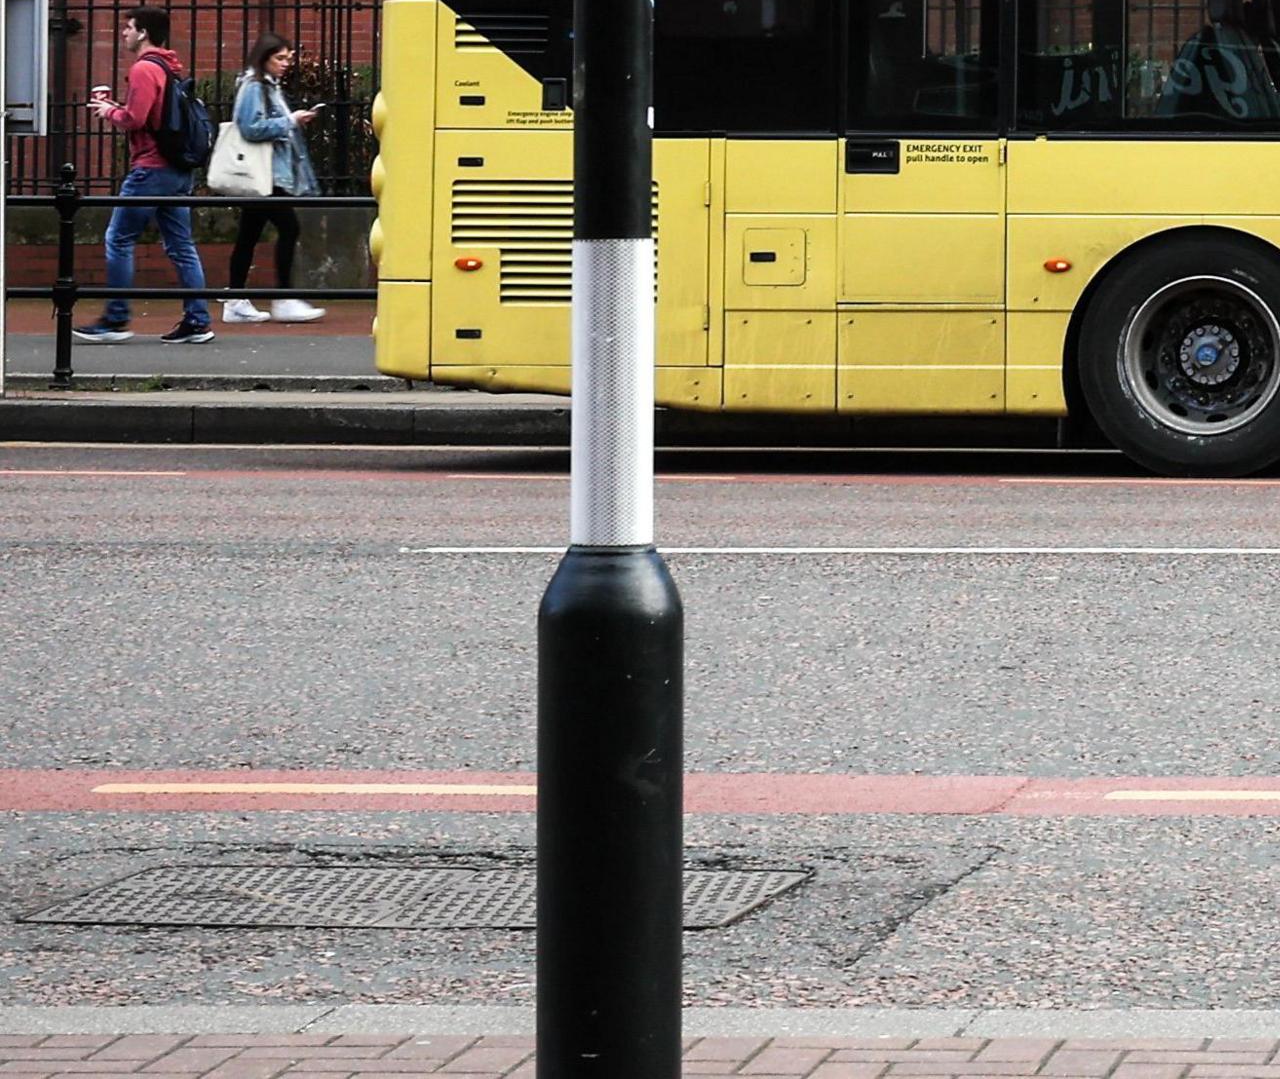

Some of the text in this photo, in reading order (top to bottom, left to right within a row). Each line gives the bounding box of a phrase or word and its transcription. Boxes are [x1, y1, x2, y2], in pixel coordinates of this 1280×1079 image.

[906, 144, 983, 153] EMERGENCY EXIT
[906, 154, 923, 164] pull
[925, 154, 954, 162] handle
[967, 156, 989, 164] open
